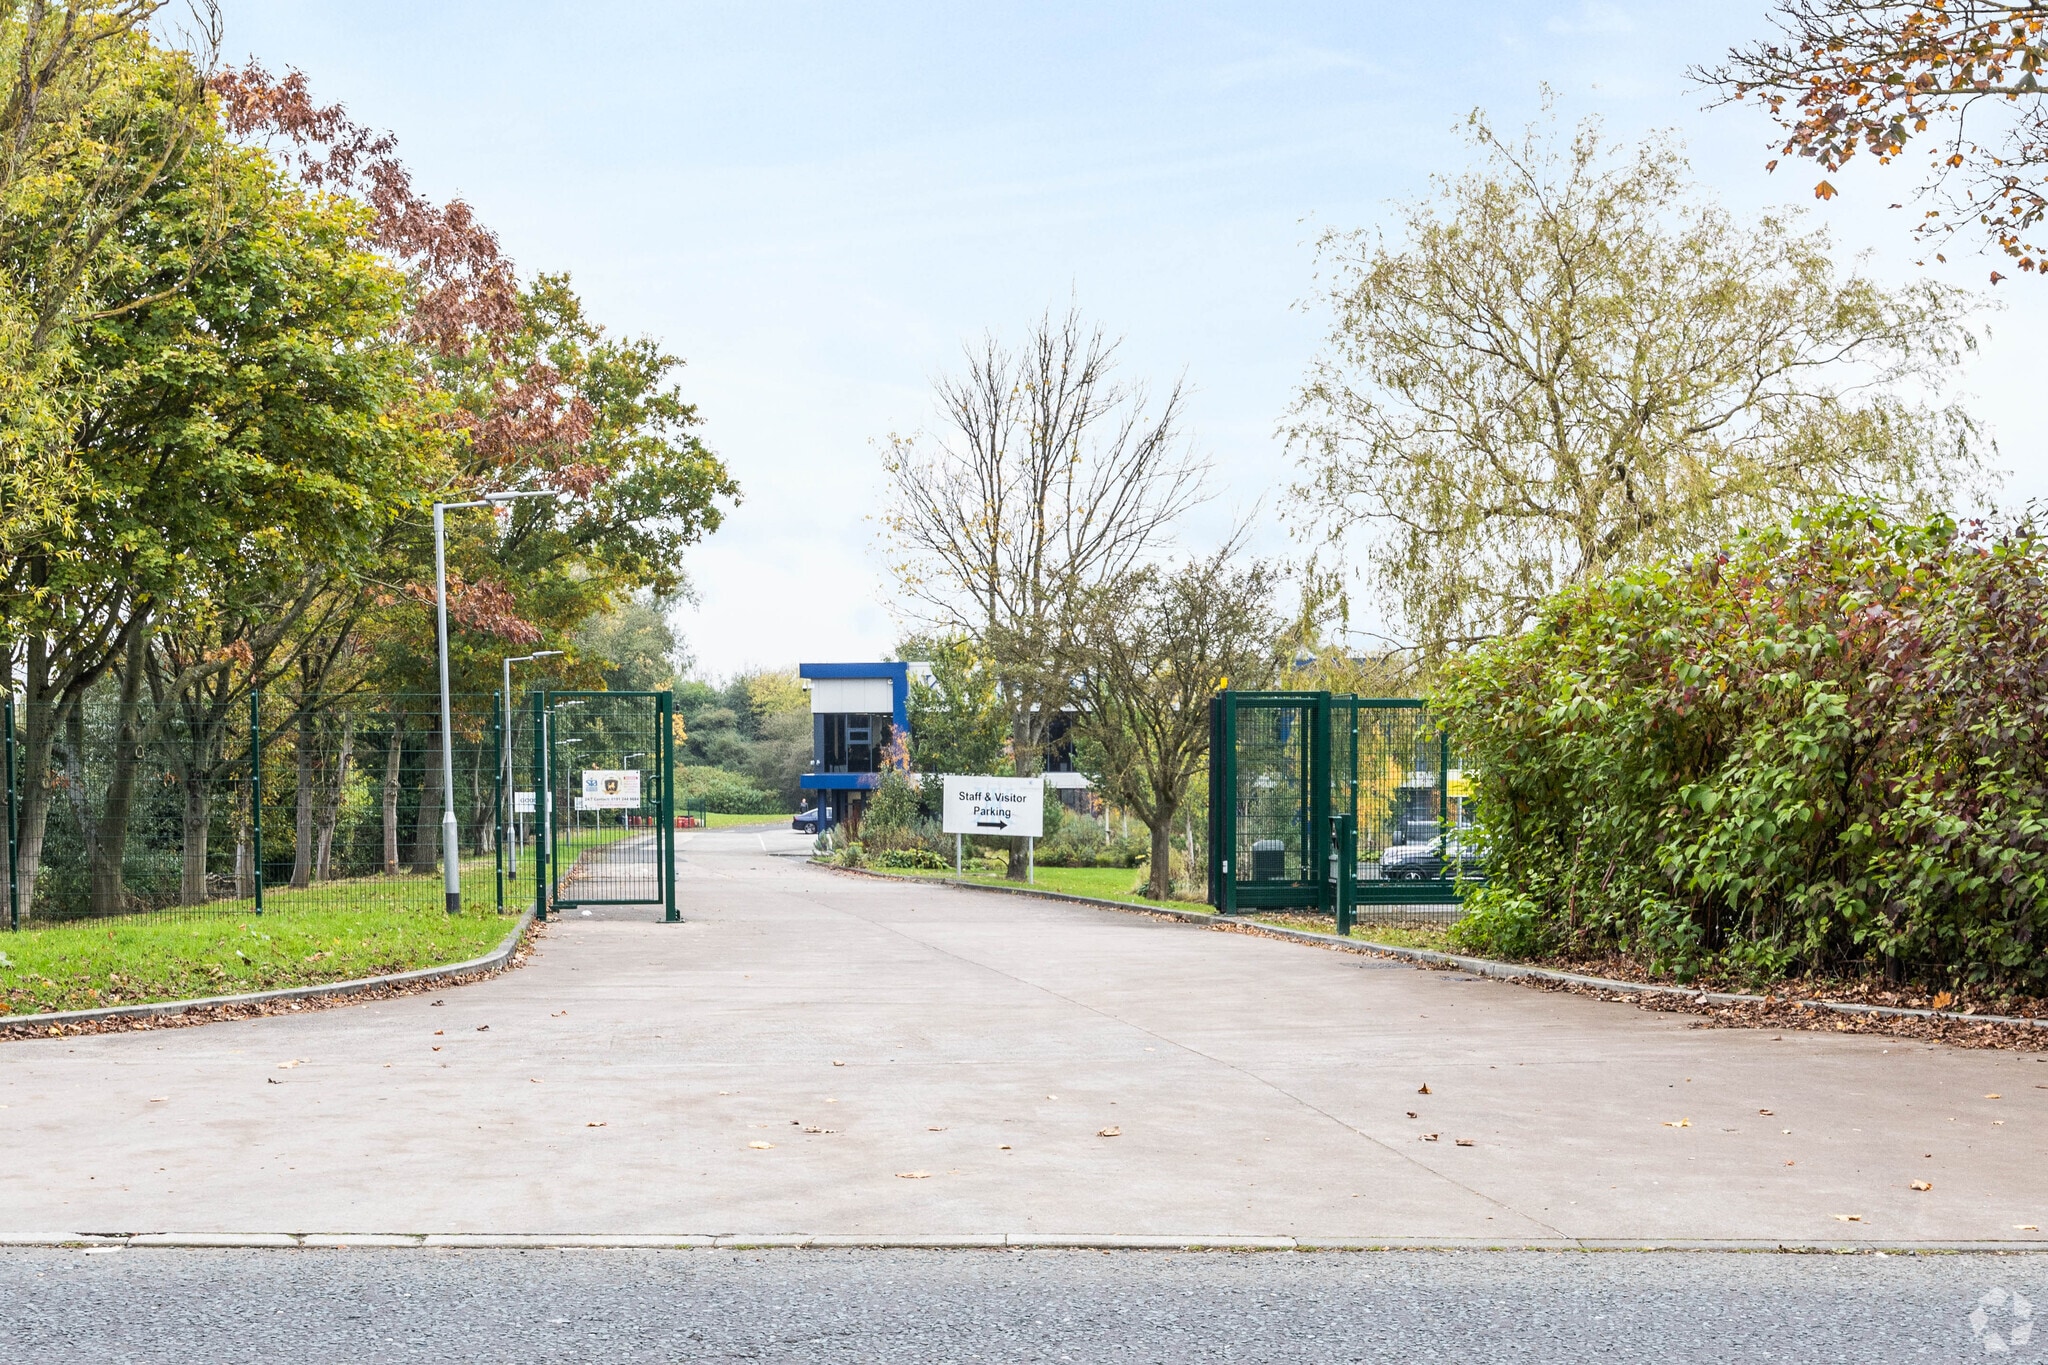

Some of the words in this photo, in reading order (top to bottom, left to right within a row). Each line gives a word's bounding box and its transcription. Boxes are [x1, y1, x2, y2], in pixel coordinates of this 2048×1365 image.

[959, 791, 982, 801] Staff
[984, 792, 992, 802] &
[995, 792, 1027, 803] Visitor
[973, 805, 1012, 819] Parking
